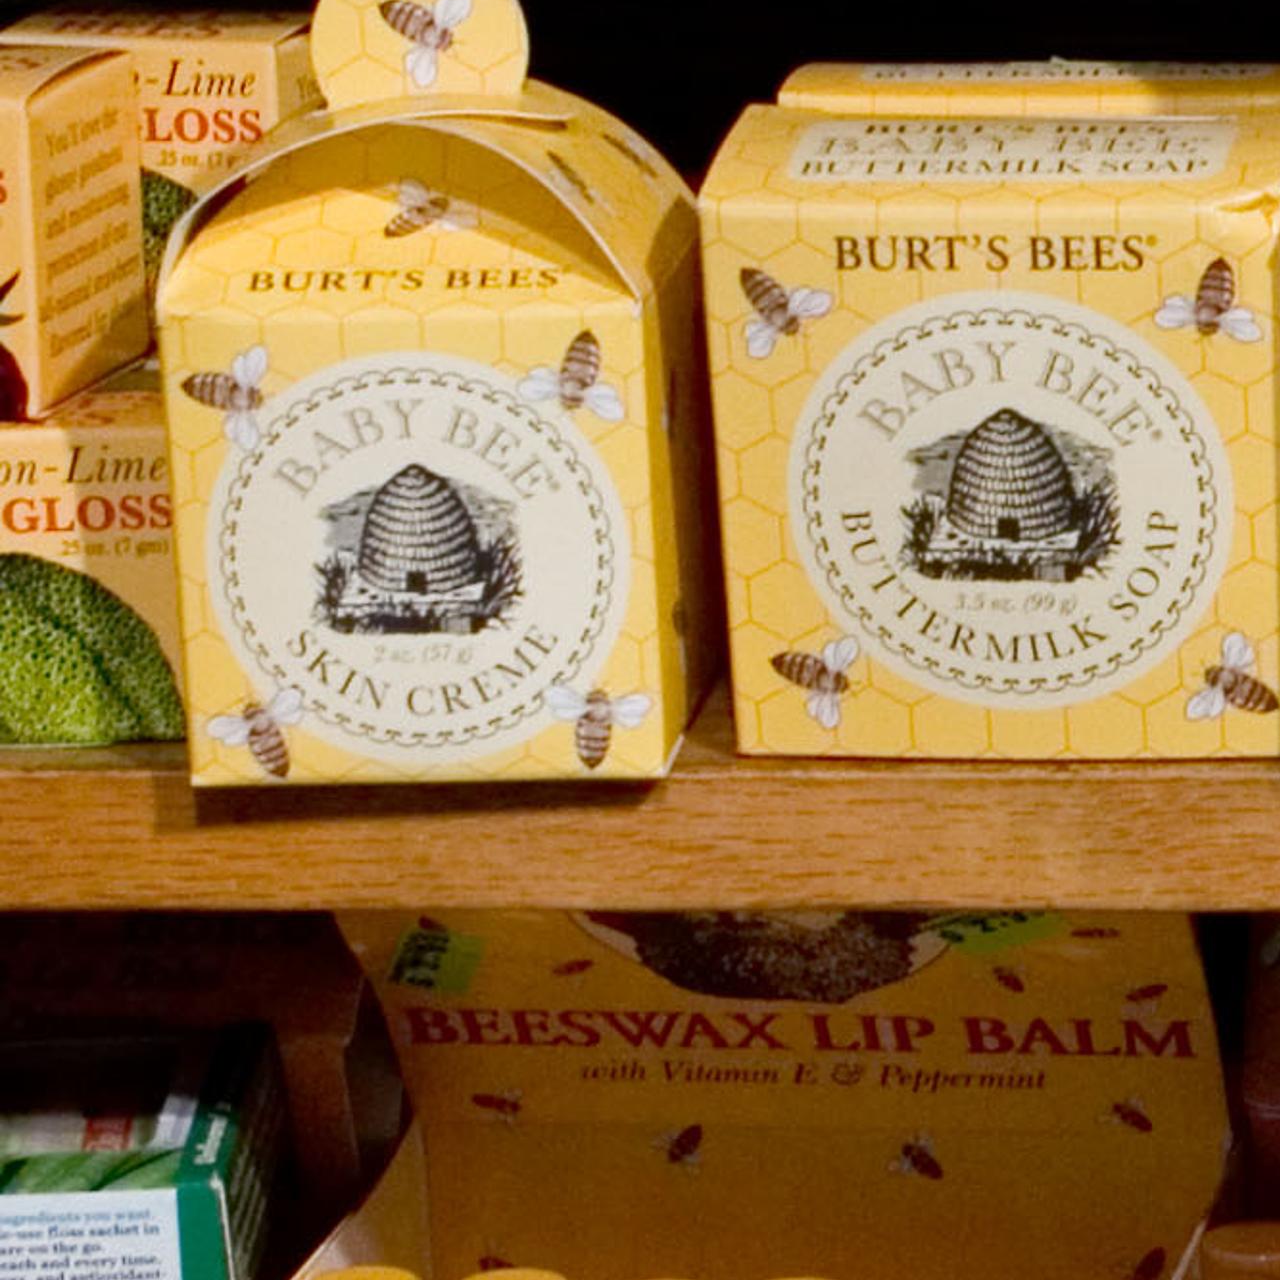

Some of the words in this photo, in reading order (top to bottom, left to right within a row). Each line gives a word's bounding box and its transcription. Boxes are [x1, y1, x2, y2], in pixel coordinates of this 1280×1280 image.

[247, 269, 428, 295] BURT'S
[447, 267, 558, 291] BEES
[271, 398, 421, 501] BABY
[440, 401, 553, 501] BEE
[285, 628, 387, 711] SKIN
[405, 621, 559, 716] CREME
[405, 1008, 789, 1052] BEESWAX
[812, 1013, 935, 1054] LIP
[965, 1016, 1198, 1059] BALM
